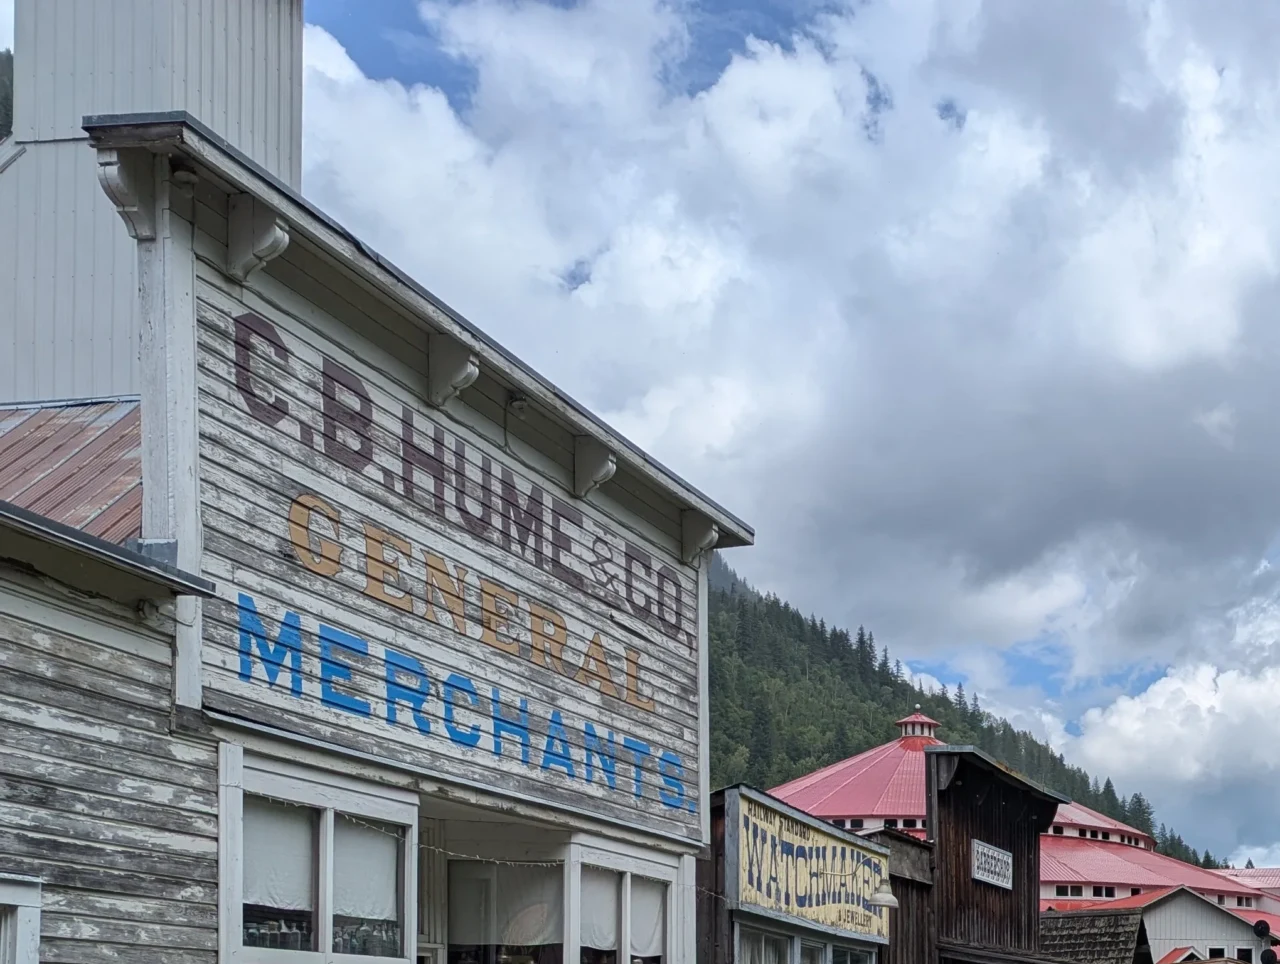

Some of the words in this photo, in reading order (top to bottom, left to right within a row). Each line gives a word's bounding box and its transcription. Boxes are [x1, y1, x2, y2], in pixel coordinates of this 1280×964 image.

[288, 494, 656, 713] GENERAL
[237, 592, 697, 815] MERCHANTS.
[743, 815, 883, 920] WATCHMAKER
[748, 802, 777, 826] RAILWAY
[779, 818, 811, 842] STANDARD
[843, 910, 873, 928] JEWELLERY
